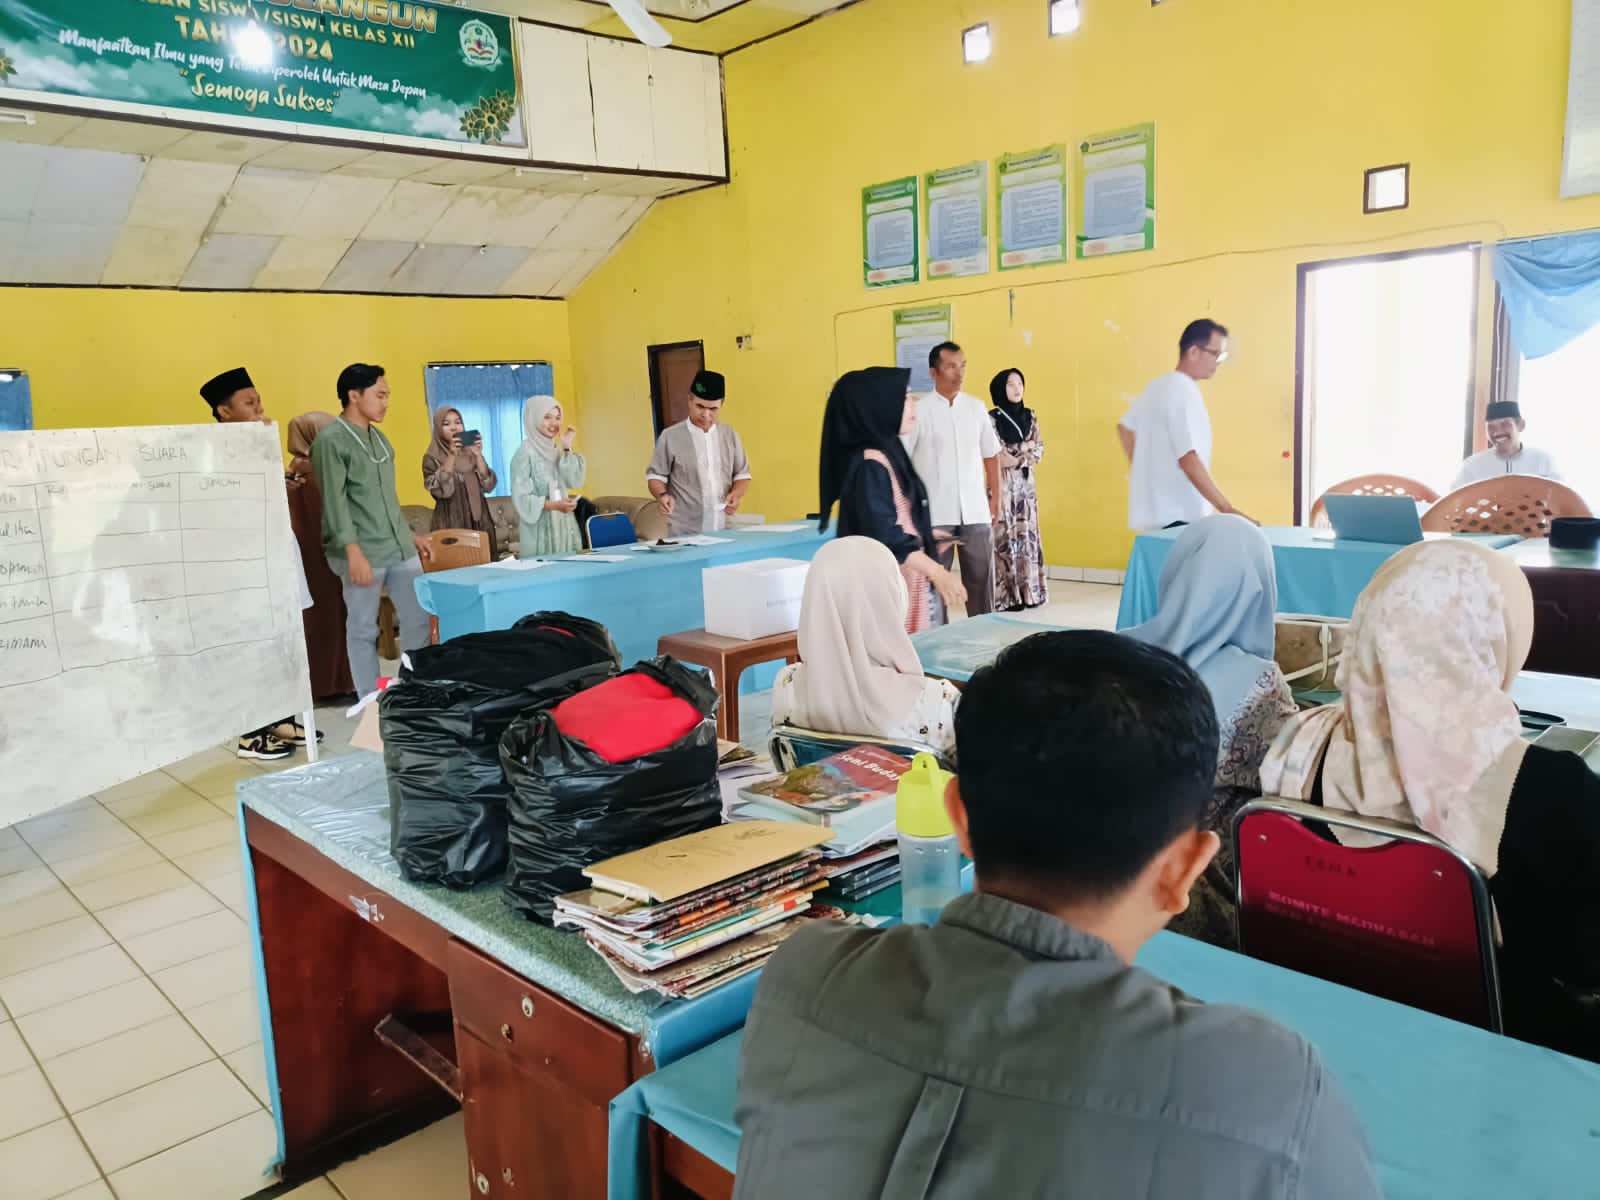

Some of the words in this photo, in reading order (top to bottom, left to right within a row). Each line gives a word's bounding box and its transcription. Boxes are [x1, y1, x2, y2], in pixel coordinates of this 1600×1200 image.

[174, 15, 229, 43] TAH
[273, 32, 334, 61] 2024
[329, 20, 388, 44] KELAS
[391, 31, 416, 49] XII
[59, 29, 151, 60] Manfaatkan
[153, 42, 186, 63] Ilmu
[188, 54, 225, 74] yang
[258, 63, 320, 84] peroleh
[321, 67, 358, 89] Untuk
[358, 73, 390, 92] Masa
[391, 77, 427, 100] Depan
